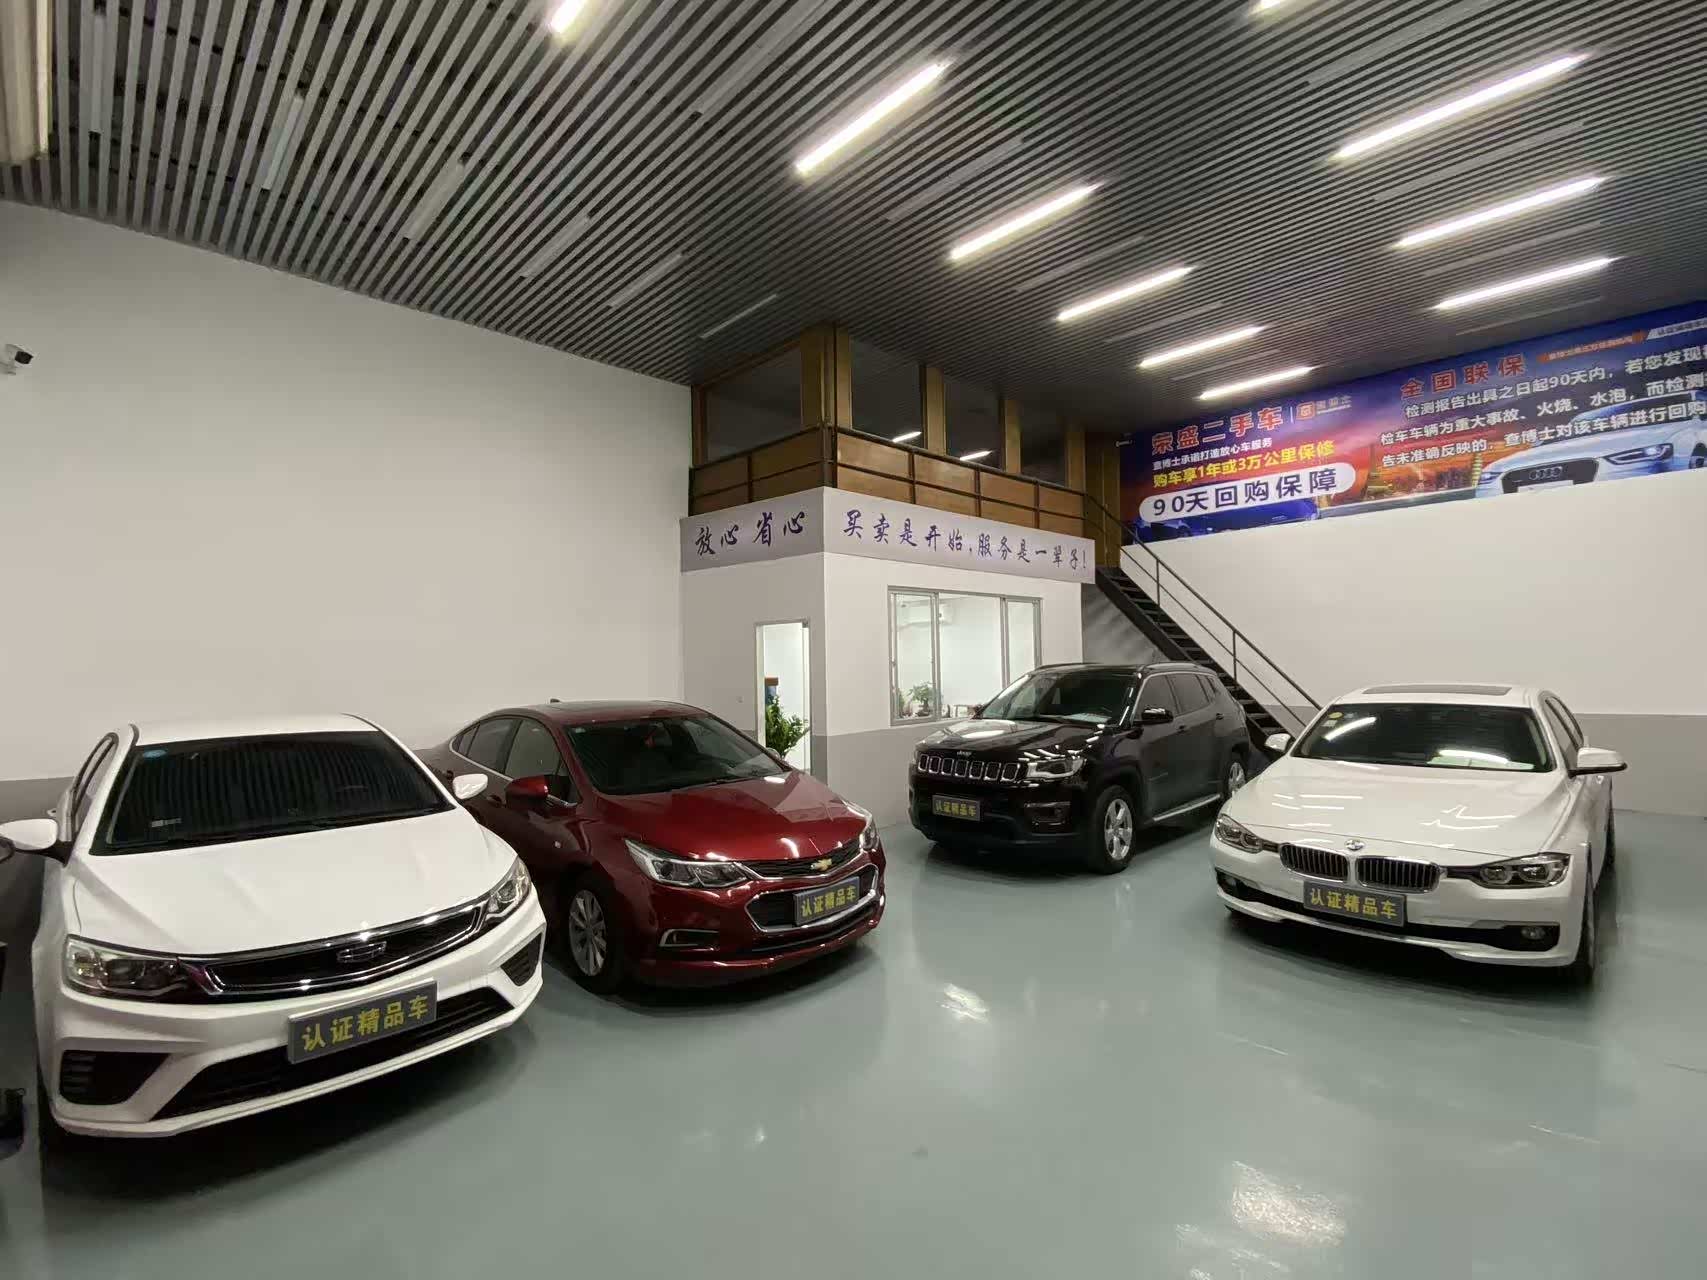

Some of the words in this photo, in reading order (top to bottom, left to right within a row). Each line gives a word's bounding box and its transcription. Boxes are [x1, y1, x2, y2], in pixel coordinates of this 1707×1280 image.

[1400, 353, 1527, 399] 全国联保
[1151, 406, 1284, 456] 荣盛二手车
[1153, 440, 1336, 489] 购车享1年或3万公里保修
[1153, 468, 1337, 516] 90天回购保障
[802, 885, 857, 917] 认证精品车
[1309, 888, 1398, 919] 认证精品车
[301, 995, 429, 1051] 认证精品车
